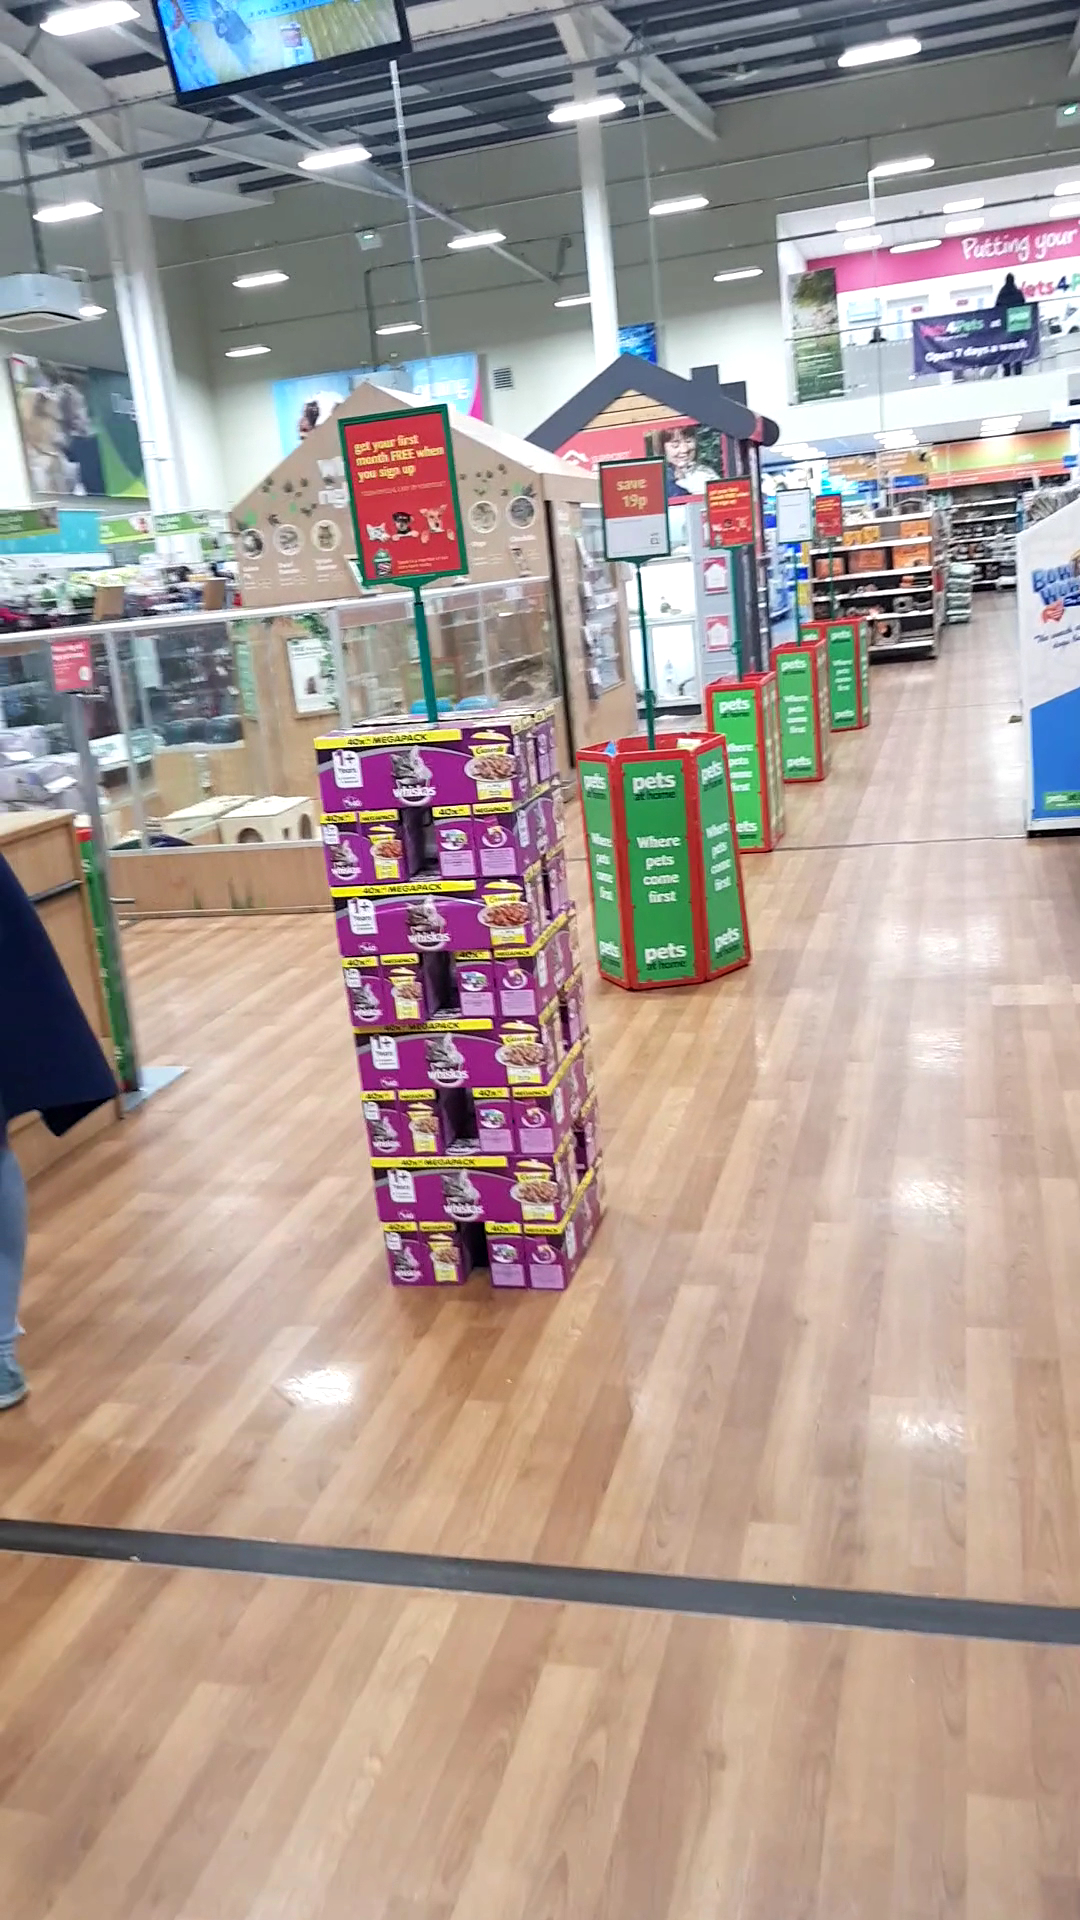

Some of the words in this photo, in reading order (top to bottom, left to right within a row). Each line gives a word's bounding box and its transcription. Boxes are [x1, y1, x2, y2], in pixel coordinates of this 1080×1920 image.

[961, 234, 1030, 262] Putting
[1033, 229, 1078, 260] your
[925, 351, 954, 363] Open
[963, 344, 988, 357] days
[353, 441, 371, 455] get
[372, 437, 396, 453] your
[397, 434, 419, 447] first
[356, 452, 389, 466] month
[390, 448, 416, 462] FREE
[416, 446, 445, 458] when
[357, 468, 377, 483] you
[378, 465, 401, 480] sign
[402, 465, 416, 478] up
[616, 478, 648, 491] save
[621, 494, 648, 510] 19p
[781, 659, 807, 672] pets
[719, 698, 751, 714] pets
[373, 734, 428, 744] MEGAPACK
[334, 749, 355, 766] 1+
[786, 756, 812, 768] pets
[701, 761, 723, 785] pets
[583, 772, 607, 791] pets
[632, 772, 676, 794] pets
[392, 785, 437, 798] whiskas
[635, 792, 645, 801] at
[646, 789, 676, 800] home
[706, 822, 729, 839] Where
[736, 820, 758, 833] ets
[590, 832, 613, 848] Where
[636, 835, 681, 849] Where
[711, 841, 728, 859] pets
[596, 854, 611, 865] pets
[646, 855, 675, 871] pets
[710, 859, 732, 874] come
[643, 874, 680, 886] come
[714, 876, 732, 892] first
[388, 884, 442, 893] MEGAPACK
[648, 890, 677, 904] first
[407, 932, 452, 943] whiskas
[714, 927, 741, 953] pets
[599, 940, 620, 958] pets
[644, 943, 687, 964] pets
[647, 961, 657, 971] at
[657, 960, 686, 971] home
[427, 1069, 470, 1080] whiskas
